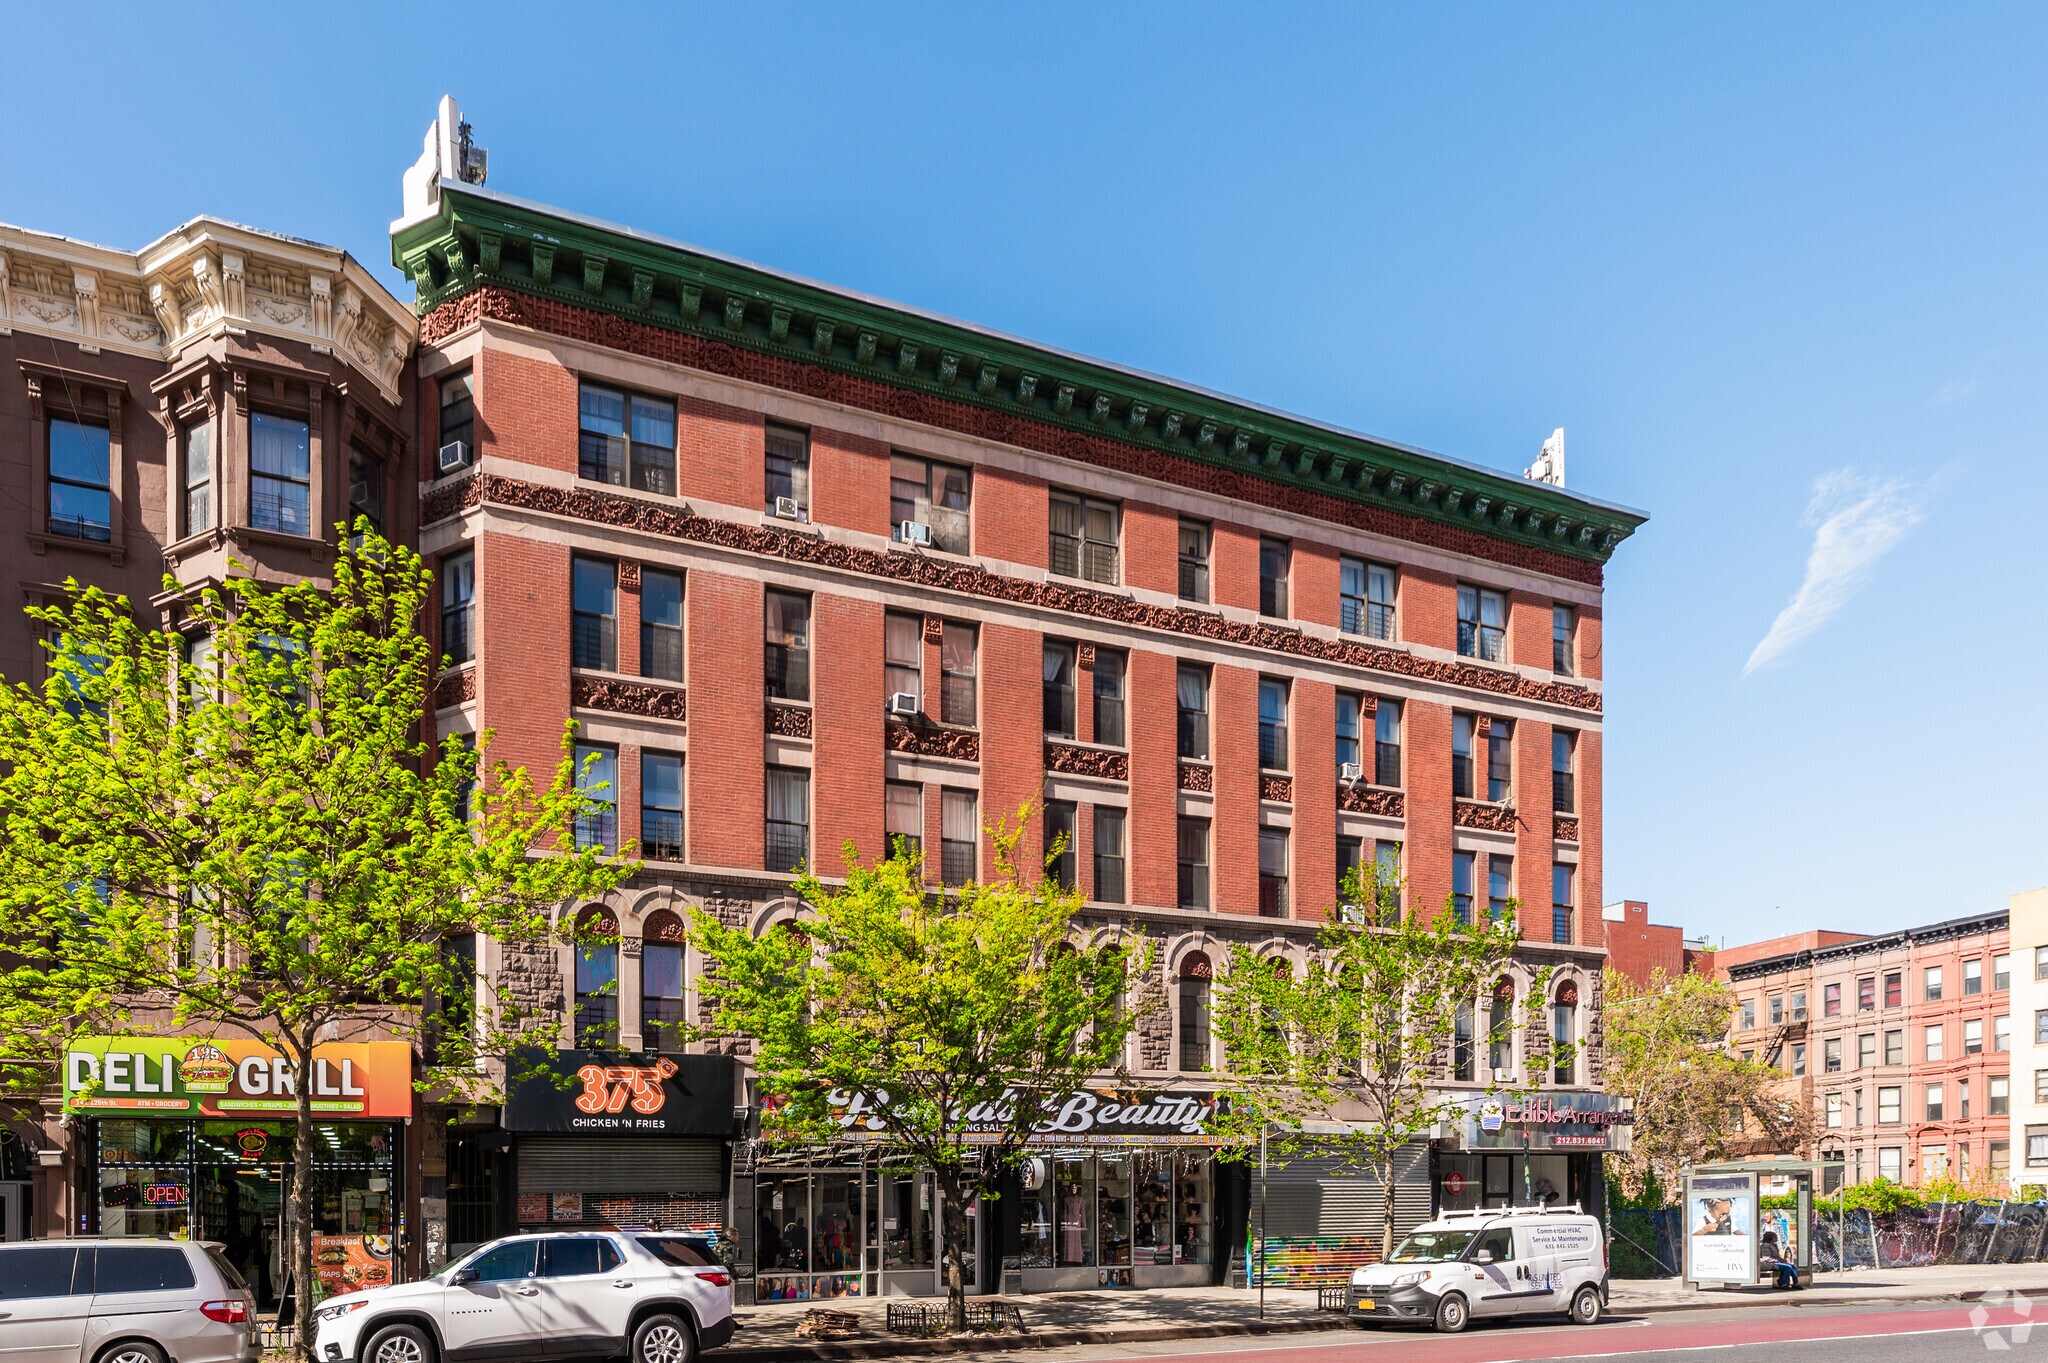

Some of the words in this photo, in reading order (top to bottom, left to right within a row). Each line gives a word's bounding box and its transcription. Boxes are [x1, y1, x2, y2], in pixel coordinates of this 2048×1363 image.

[191, 1047, 219, 1060] 125
[68, 1051, 173, 1093] DELI
[575, 1064, 666, 1115] 375
[219, 1101, 259, 1109] SANDWICHES
[1506, 1099, 1562, 1123] Edible
[1029, 1091, 1212, 1134] Beauty
[572, 1118, 619, 1128] CHICKEN
[636, 1119, 666, 1129] FRIES
[1557, 1136, 1604, 1145] 212.831.6041
[147, 1187, 186, 1202] OPEN
[321, 1238, 361, 1246] Breakfast
